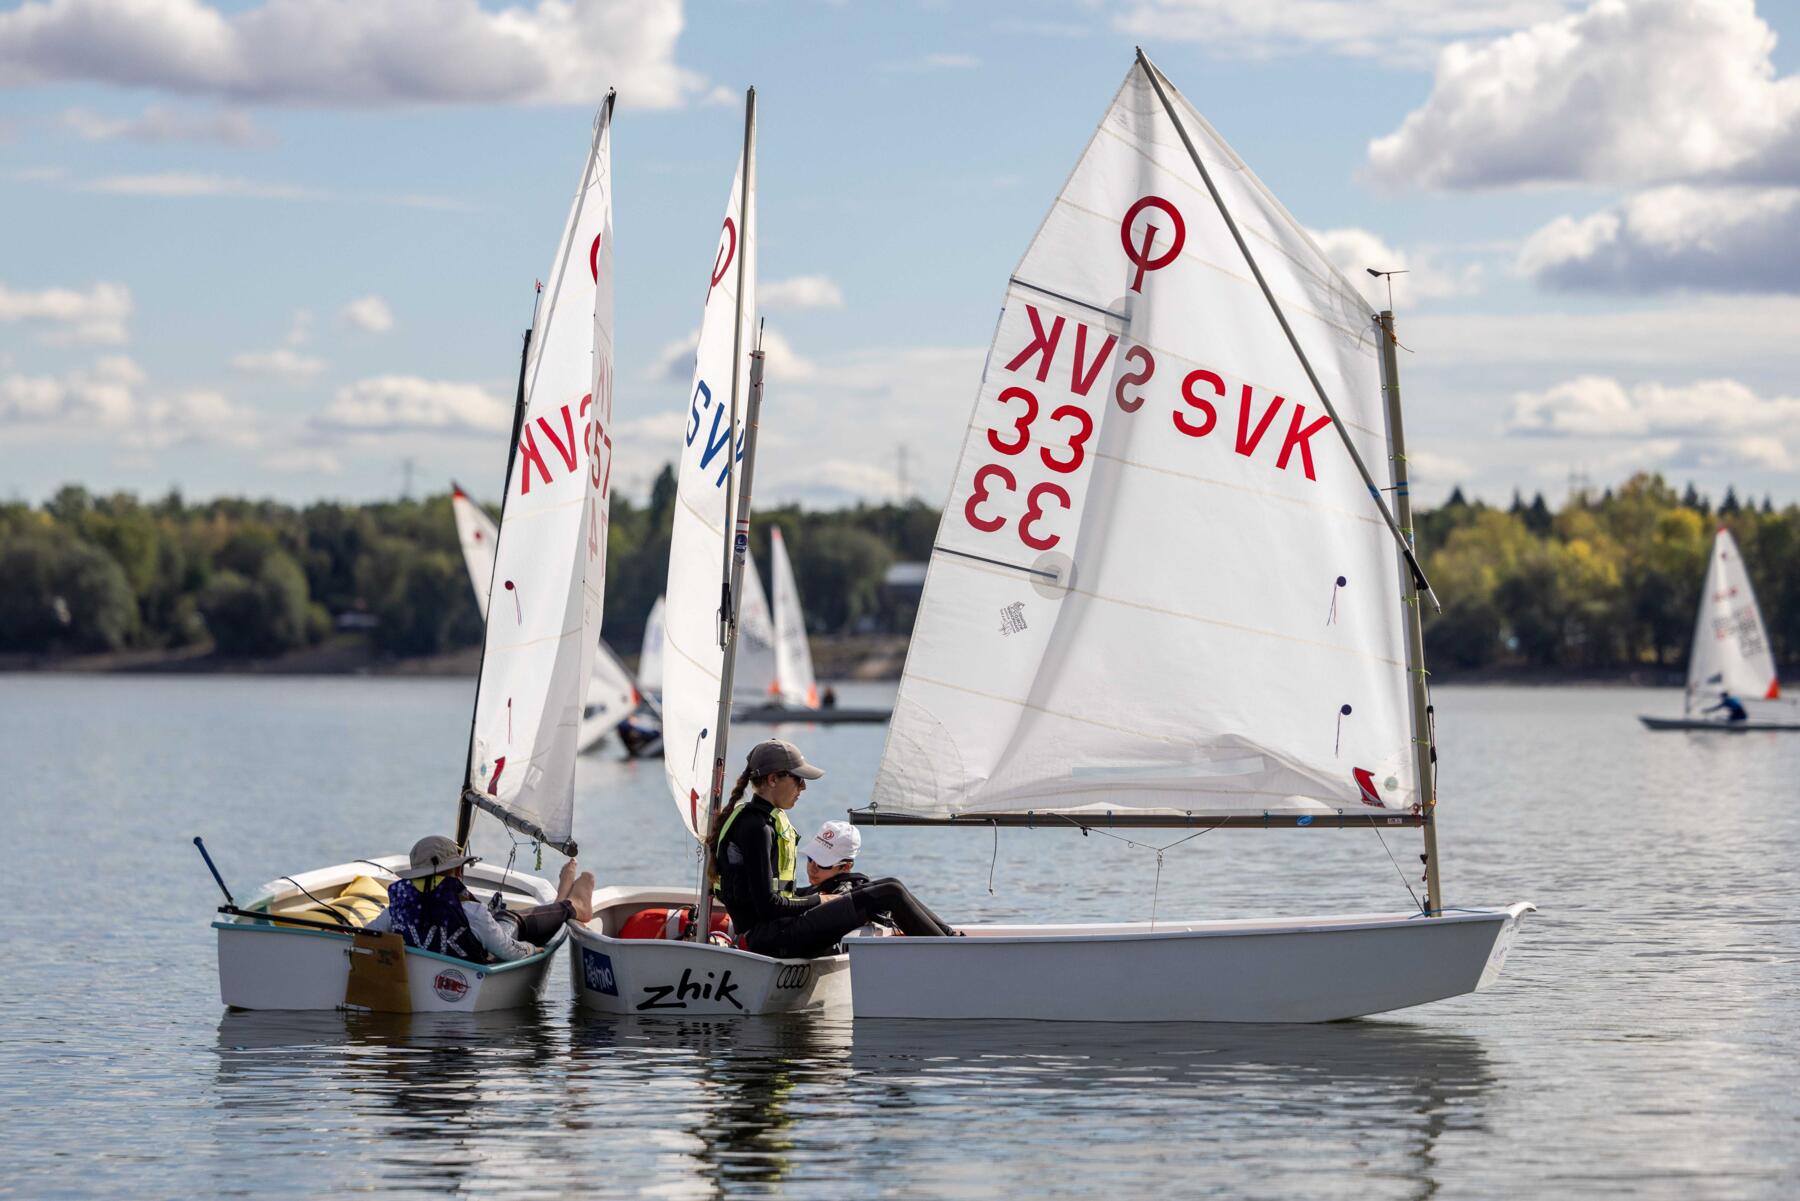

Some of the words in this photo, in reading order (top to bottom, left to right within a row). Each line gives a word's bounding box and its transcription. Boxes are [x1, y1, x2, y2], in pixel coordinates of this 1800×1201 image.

[987, 386, 1093, 474] 33
[1173, 369, 1333, 482] SVK
[392, 923, 468, 957] VK
[636, 968, 743, 1011] zhik
